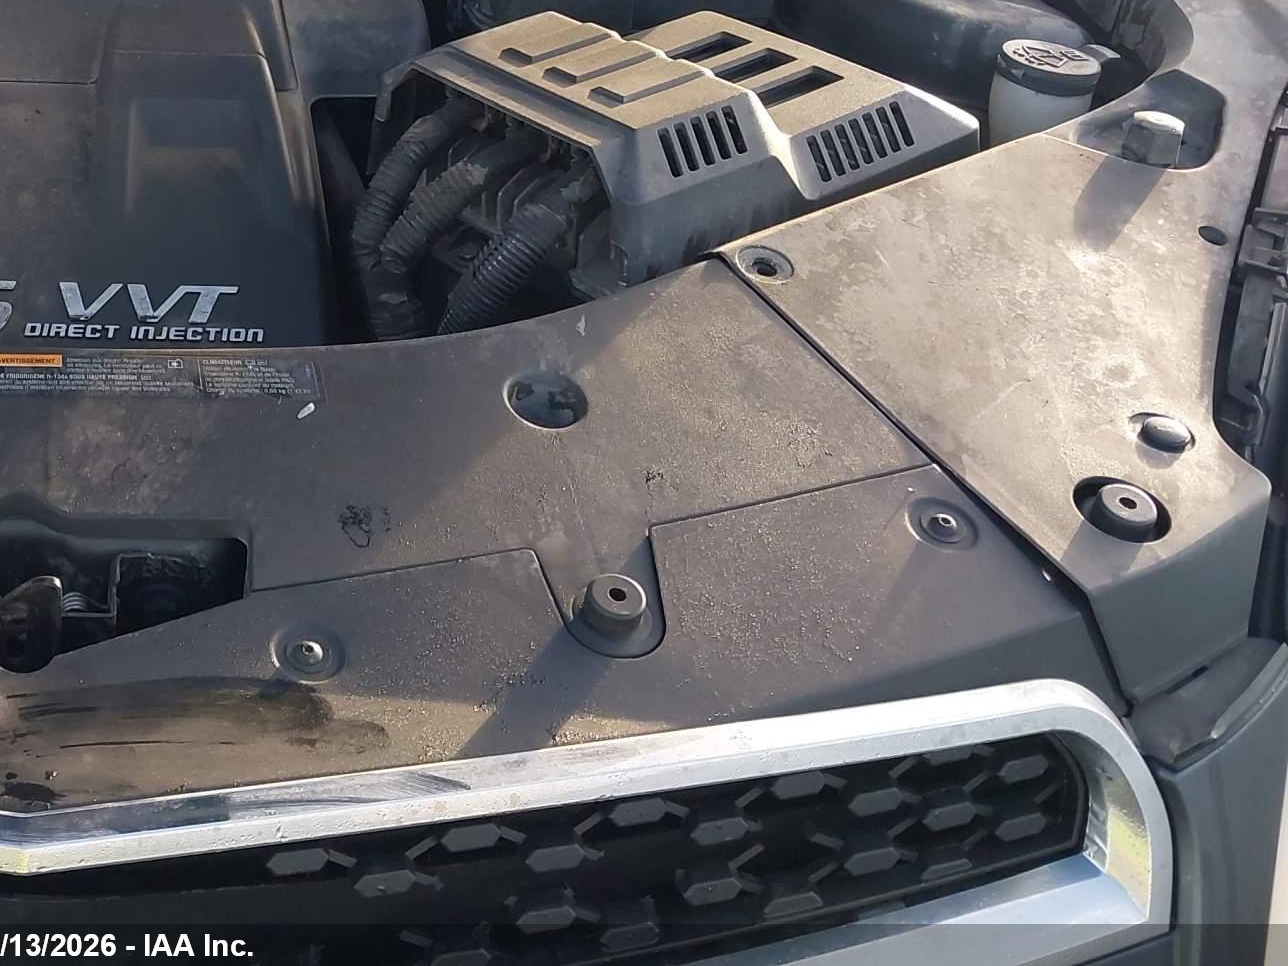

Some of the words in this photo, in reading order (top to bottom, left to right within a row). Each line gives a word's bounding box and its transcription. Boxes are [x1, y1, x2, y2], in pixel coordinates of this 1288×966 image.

[58, 281, 239, 323] VVT
[23, 322, 121, 339] DIRECT
[129, 325, 265, 342] INJECTION
